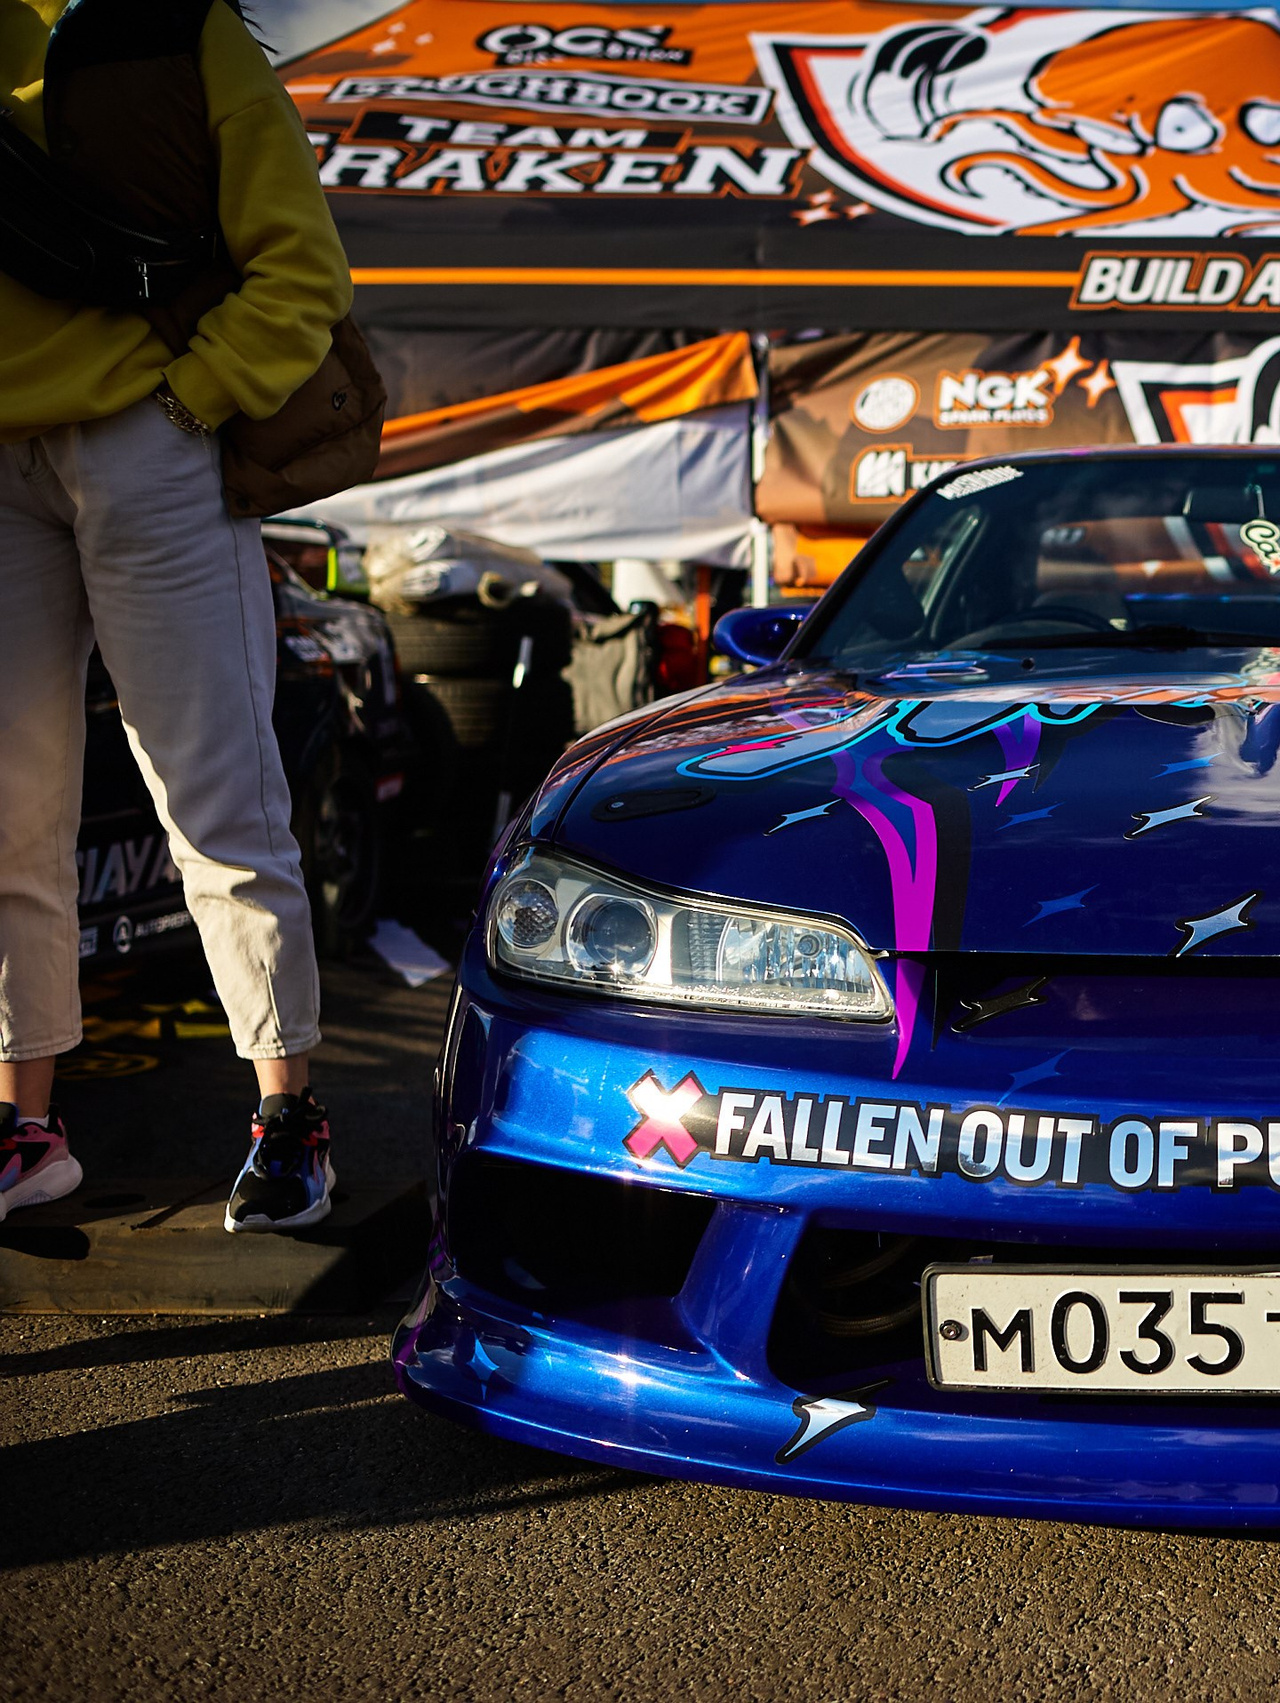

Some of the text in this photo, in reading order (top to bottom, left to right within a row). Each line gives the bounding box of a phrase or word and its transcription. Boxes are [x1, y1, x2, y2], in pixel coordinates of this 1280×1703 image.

[399, 115, 647, 147] TEAM
[1079, 259, 1244, 306] BUILD
[939, 372, 1051, 409] NGK
[716, 1091, 944, 1172] FALLEN
[957, 1109, 1093, 1184] OUT
[1108, 1119, 1197, 1188] OF
